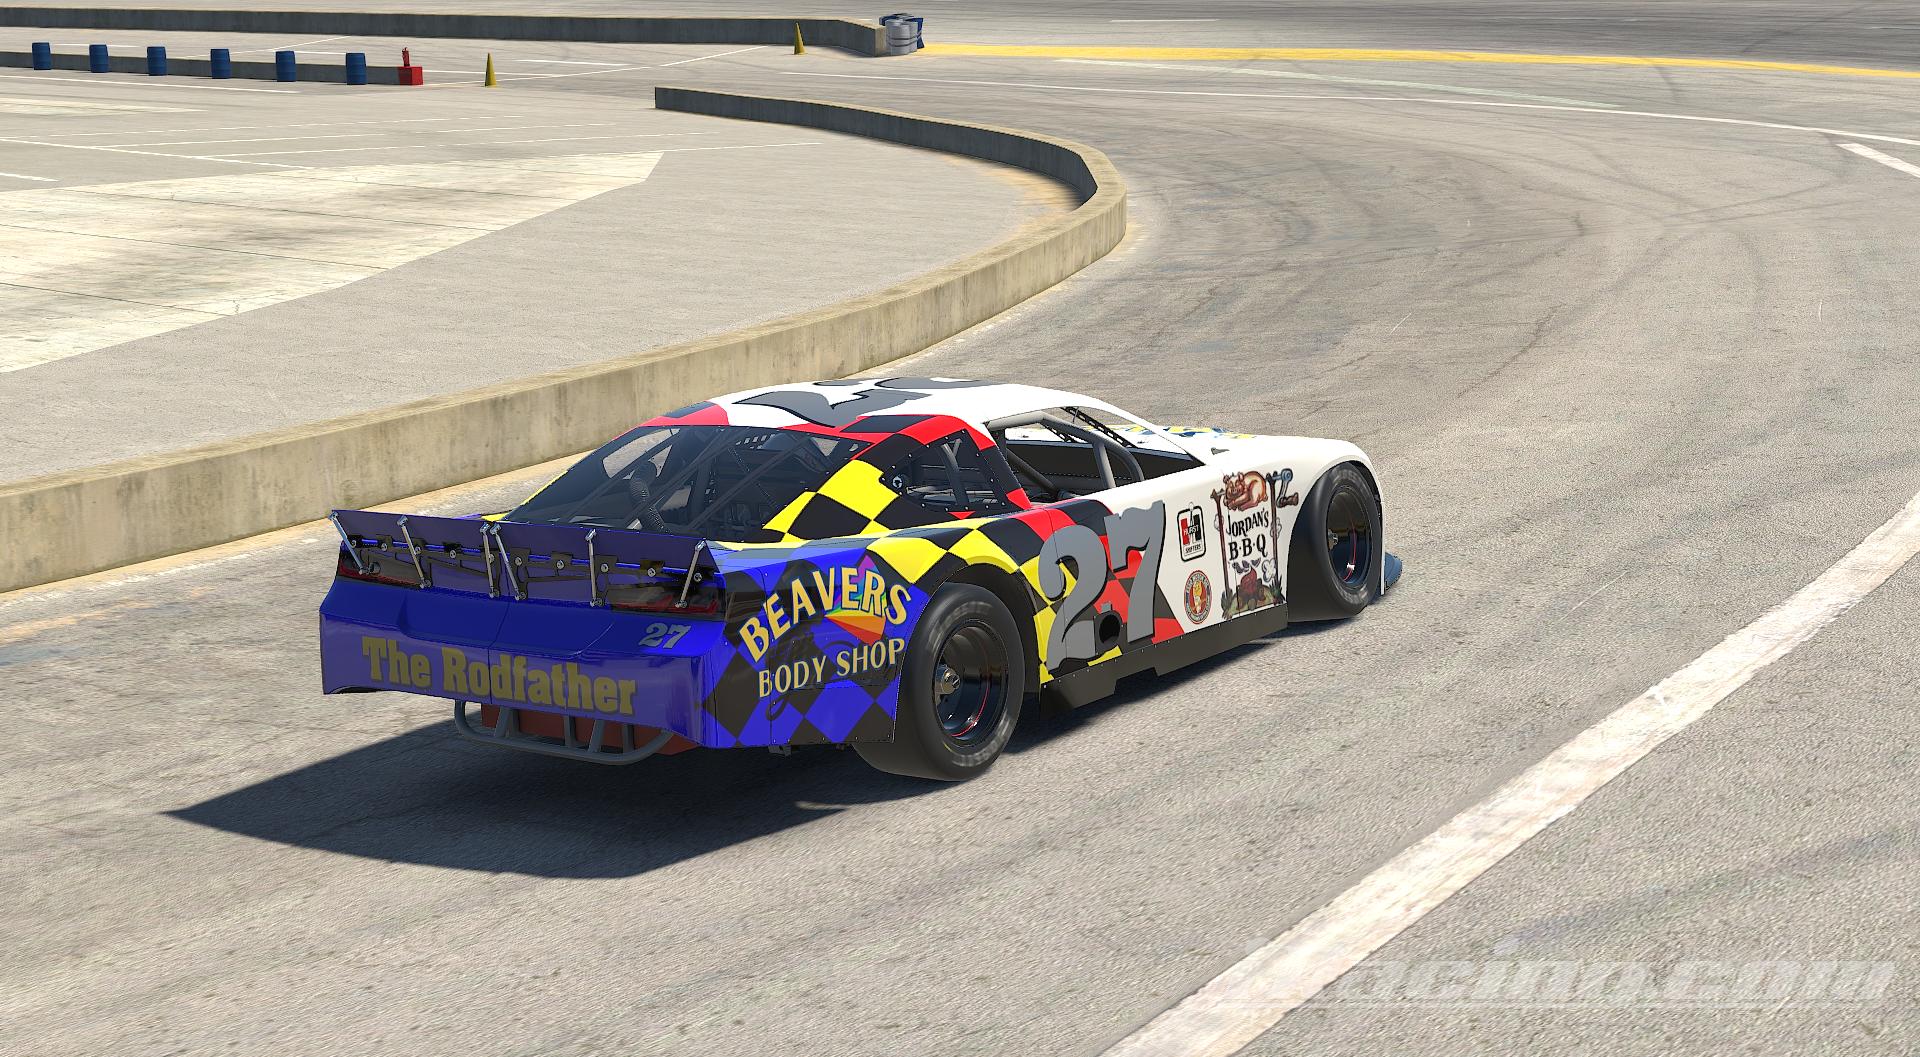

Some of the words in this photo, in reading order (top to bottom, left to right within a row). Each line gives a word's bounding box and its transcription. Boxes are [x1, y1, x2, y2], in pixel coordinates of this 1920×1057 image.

[1225, 507, 1269, 537] JORDAN'S
[739, 567, 912, 663] BEAVERS
[1038, 499, 1166, 674] 27
[638, 622, 691, 649] 27
[759, 655, 827, 698] BODY
[836, 638, 906, 677] SHOP
[362, 636, 432, 688] The
[442, 646, 636, 715] Rodfather
